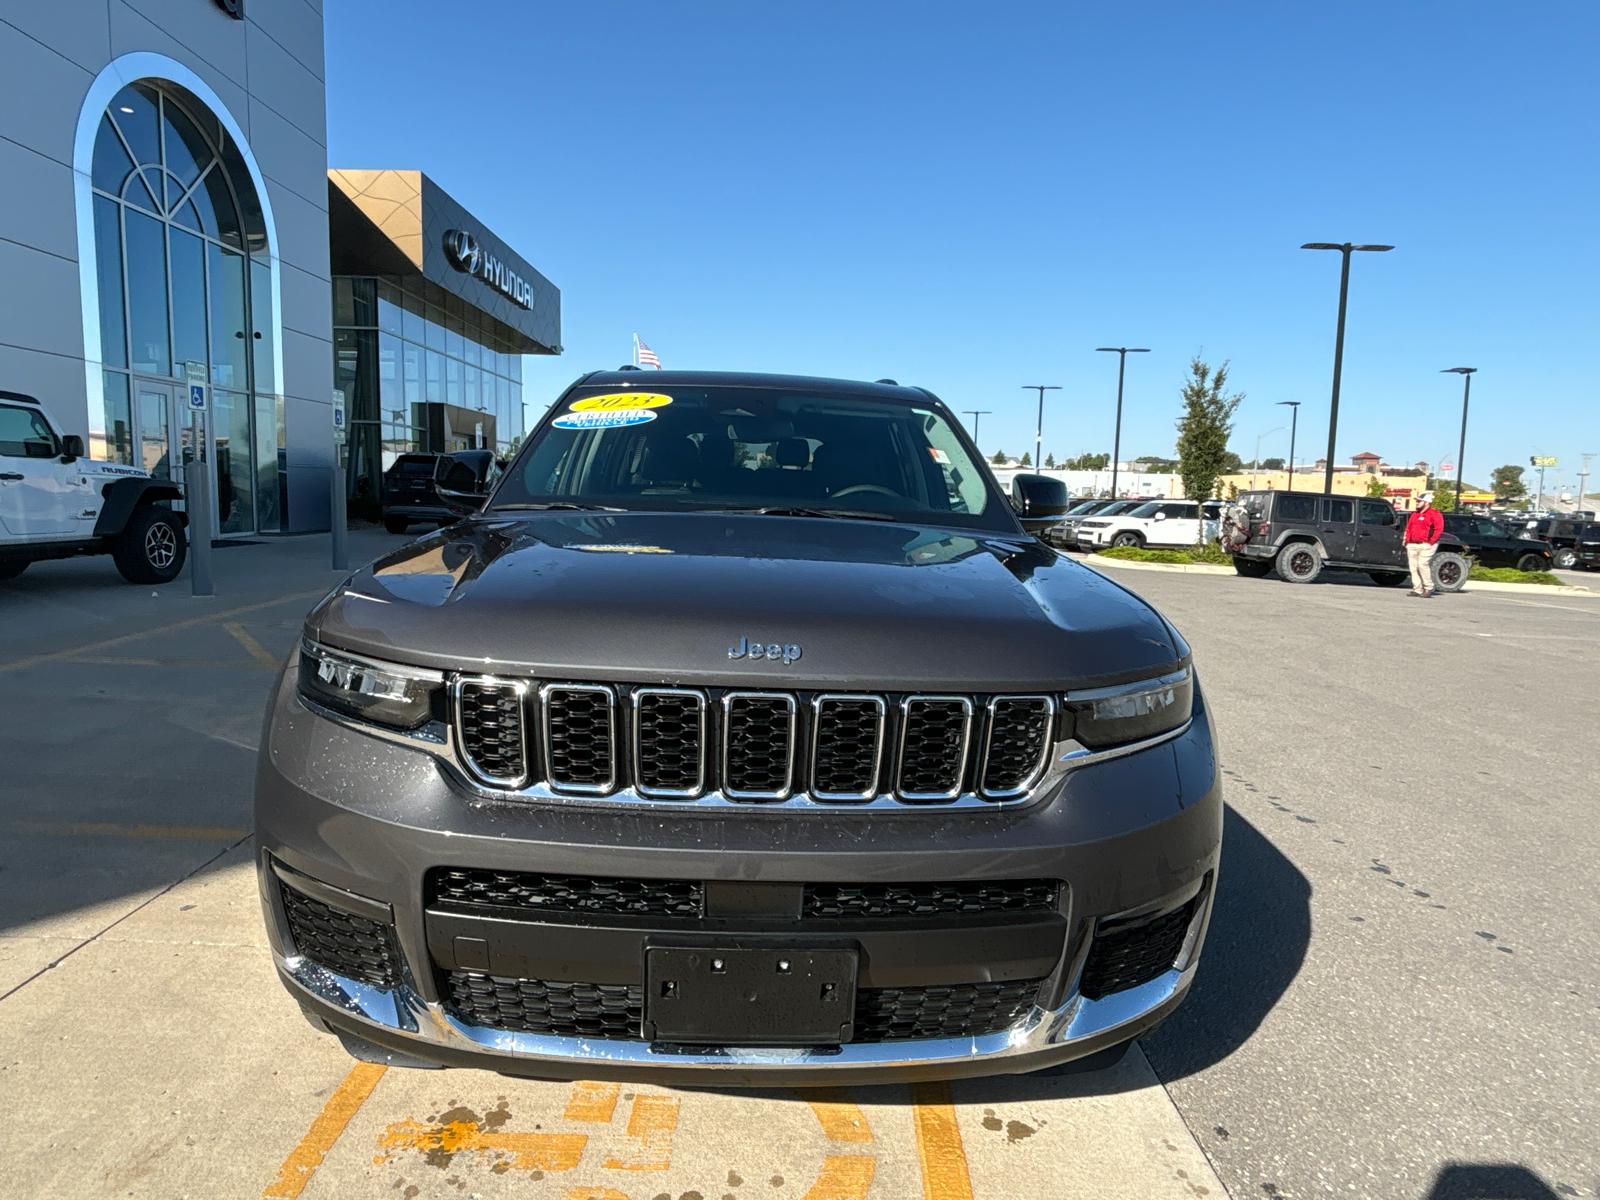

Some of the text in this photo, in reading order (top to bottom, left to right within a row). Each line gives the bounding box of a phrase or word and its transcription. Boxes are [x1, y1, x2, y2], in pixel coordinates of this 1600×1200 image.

[484, 250, 534, 310] HYUNDAI
[583, 396, 656, 410] 2023
[566, 409, 647, 421] CERTIFIED
[101, 466, 148, 477] RUBICON
[82, 509, 97, 517] Jeep
[727, 636, 802, 665] Jeep
